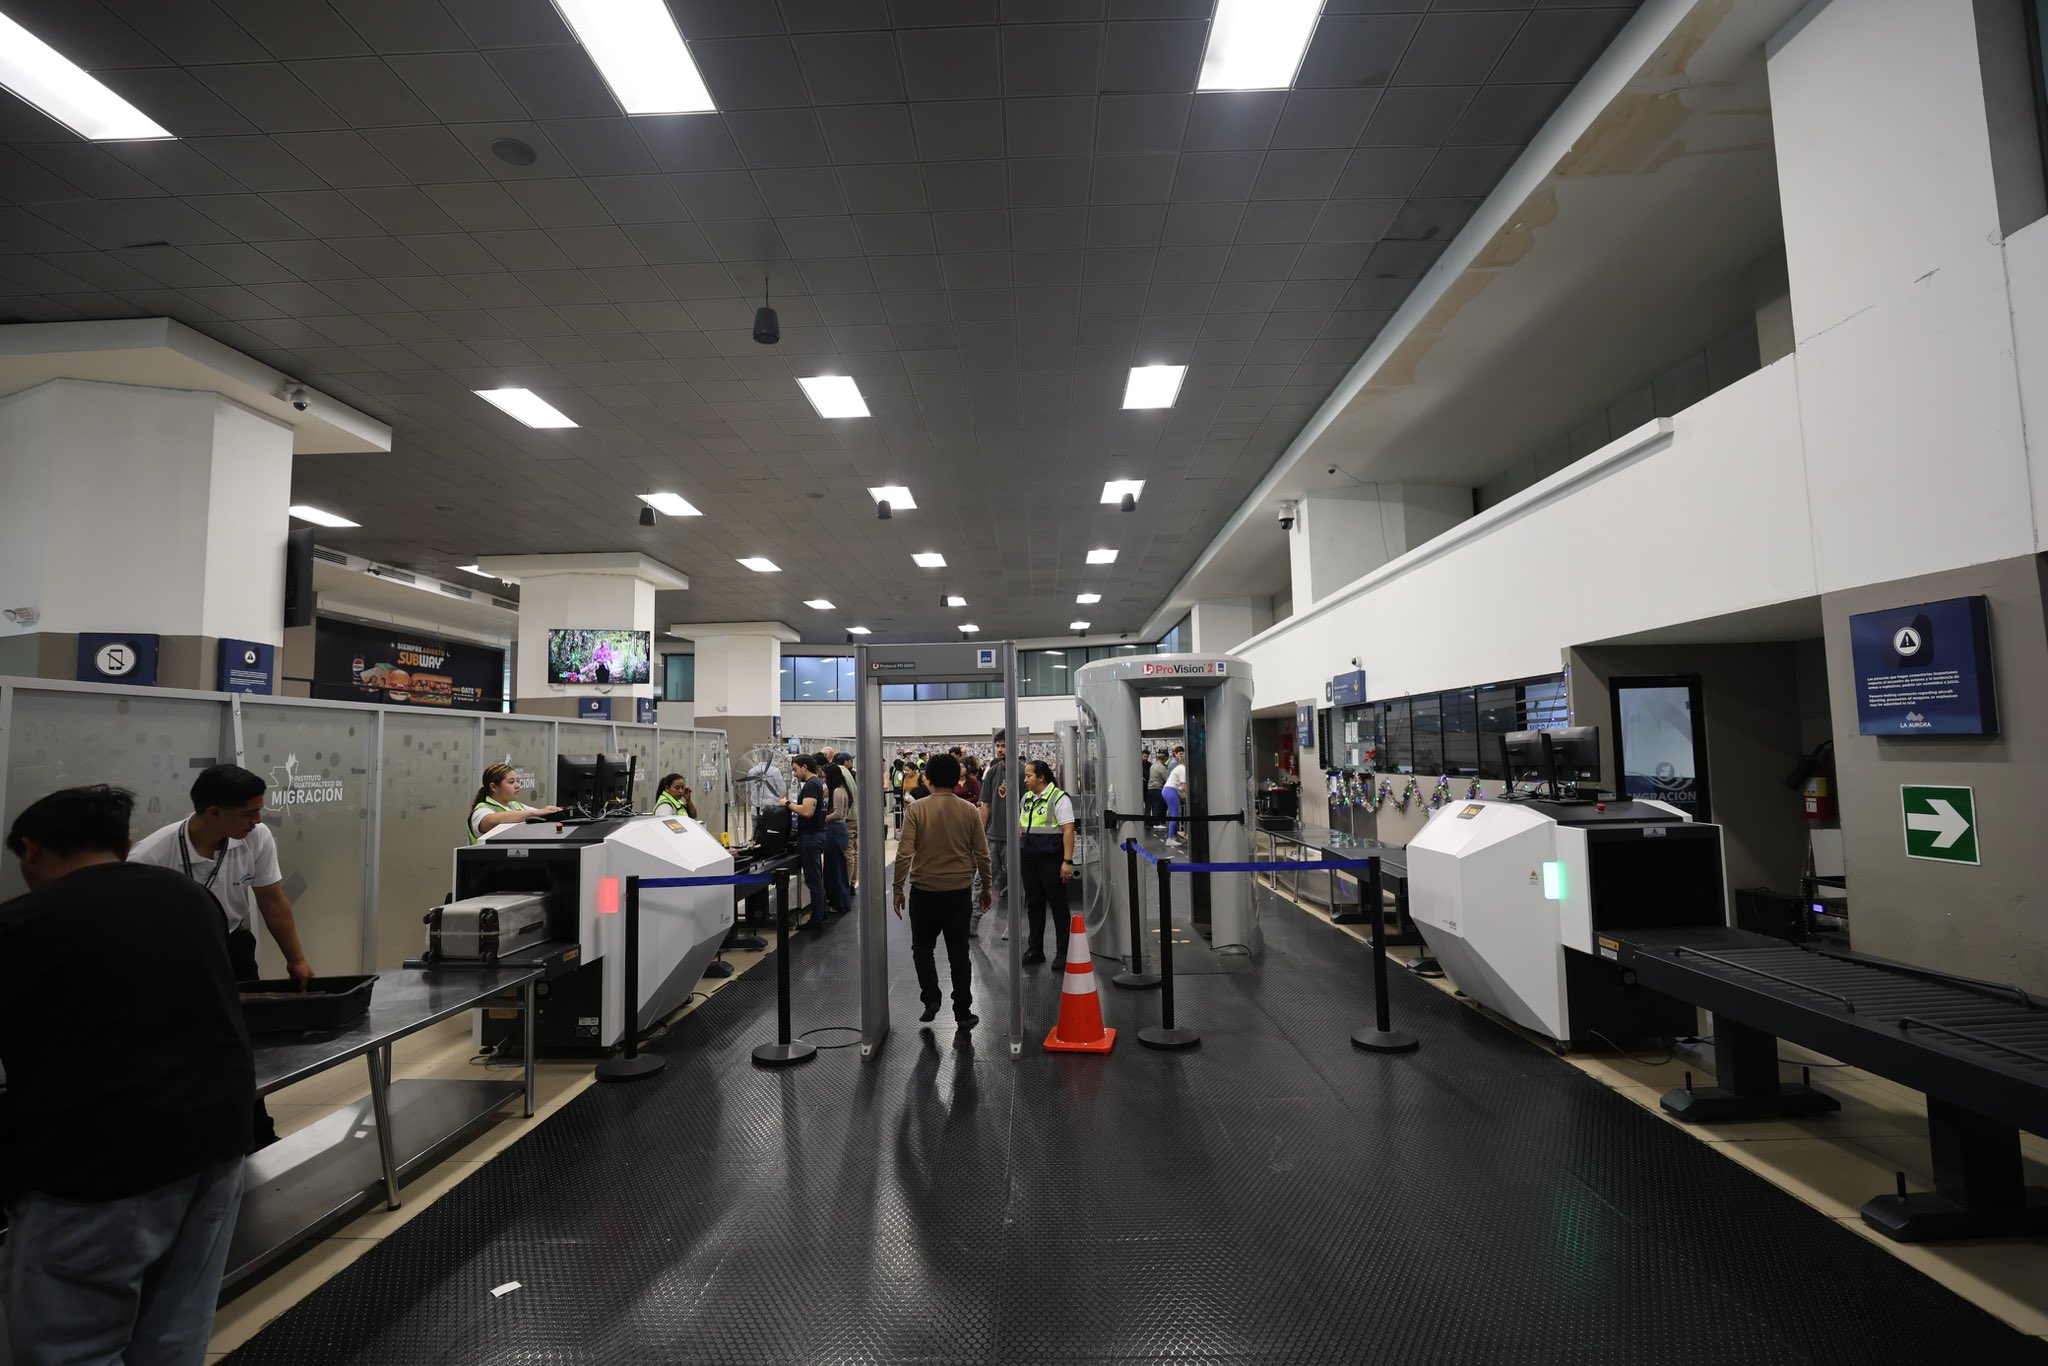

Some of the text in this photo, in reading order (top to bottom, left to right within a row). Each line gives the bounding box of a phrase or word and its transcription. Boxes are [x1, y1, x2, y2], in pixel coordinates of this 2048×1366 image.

[397, 651, 444, 669] SUBWAY
[1156, 664, 1204, 674] ProVision
[1207, 662, 1213, 672] 2
[272, 786, 343, 805] MIGRACIÓN
